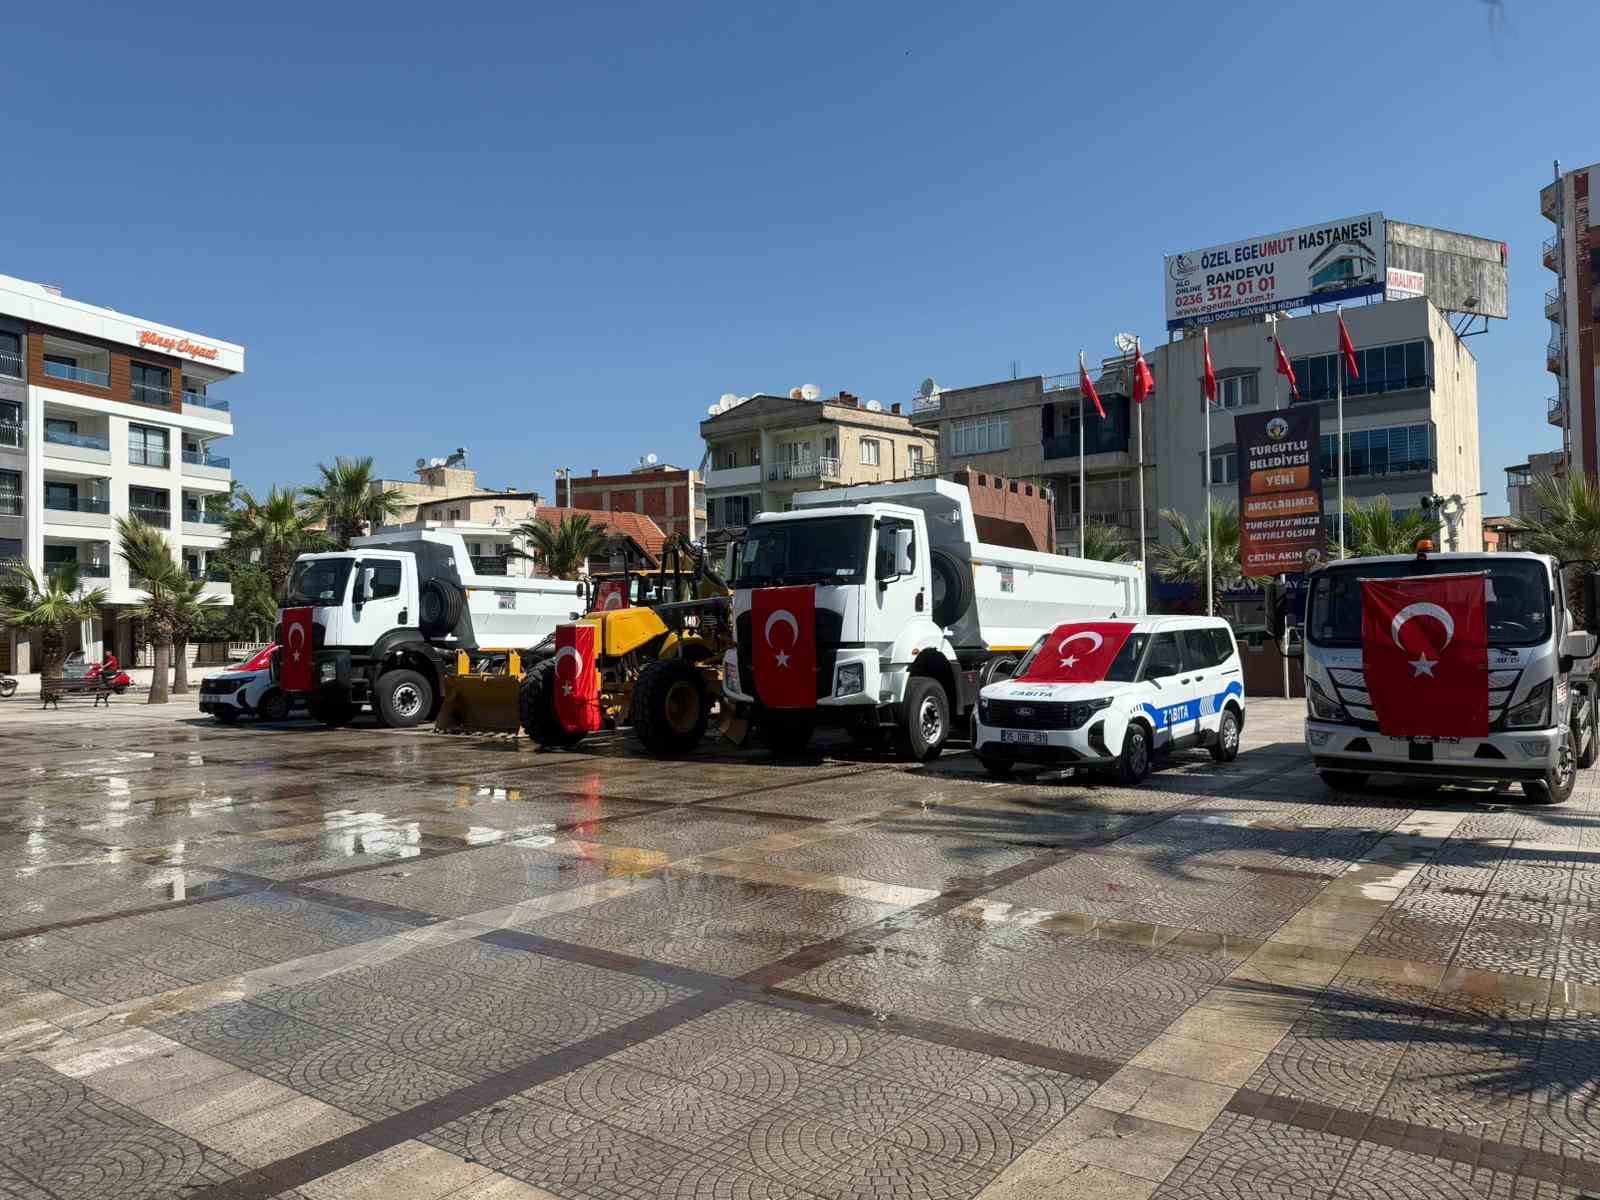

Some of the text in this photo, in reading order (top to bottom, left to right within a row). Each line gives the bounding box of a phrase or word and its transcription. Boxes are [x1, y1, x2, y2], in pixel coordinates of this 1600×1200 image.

[1201, 216, 1372, 269] ÖZEL EGEUMUT HASTANESİ
[1206, 262, 1274, 286] RANDEVU
[1175, 276, 1275, 307] 0236 312 01 01
[1176, 280, 1190, 288] ALO
[1175, 293, 1274, 316] www.egeumut.com.tr
[1249, 440, 1308, 456] TURGUTLU
[1249, 451, 1309, 470] BELEDİYESİ
[1265, 473, 1295, 487] YENİ
[1247, 496, 1314, 511] ARAÇLARIMIZ
[1245, 516, 1320, 530] TURGUTLU'MUZA
[1249, 527, 1316, 541] HAYIRLI OLSUN
[1278, 551, 1302, 561] AKIN
[1009, 690, 1053, 698] ZABITA
[1162, 704, 1190, 724] ZABITA
